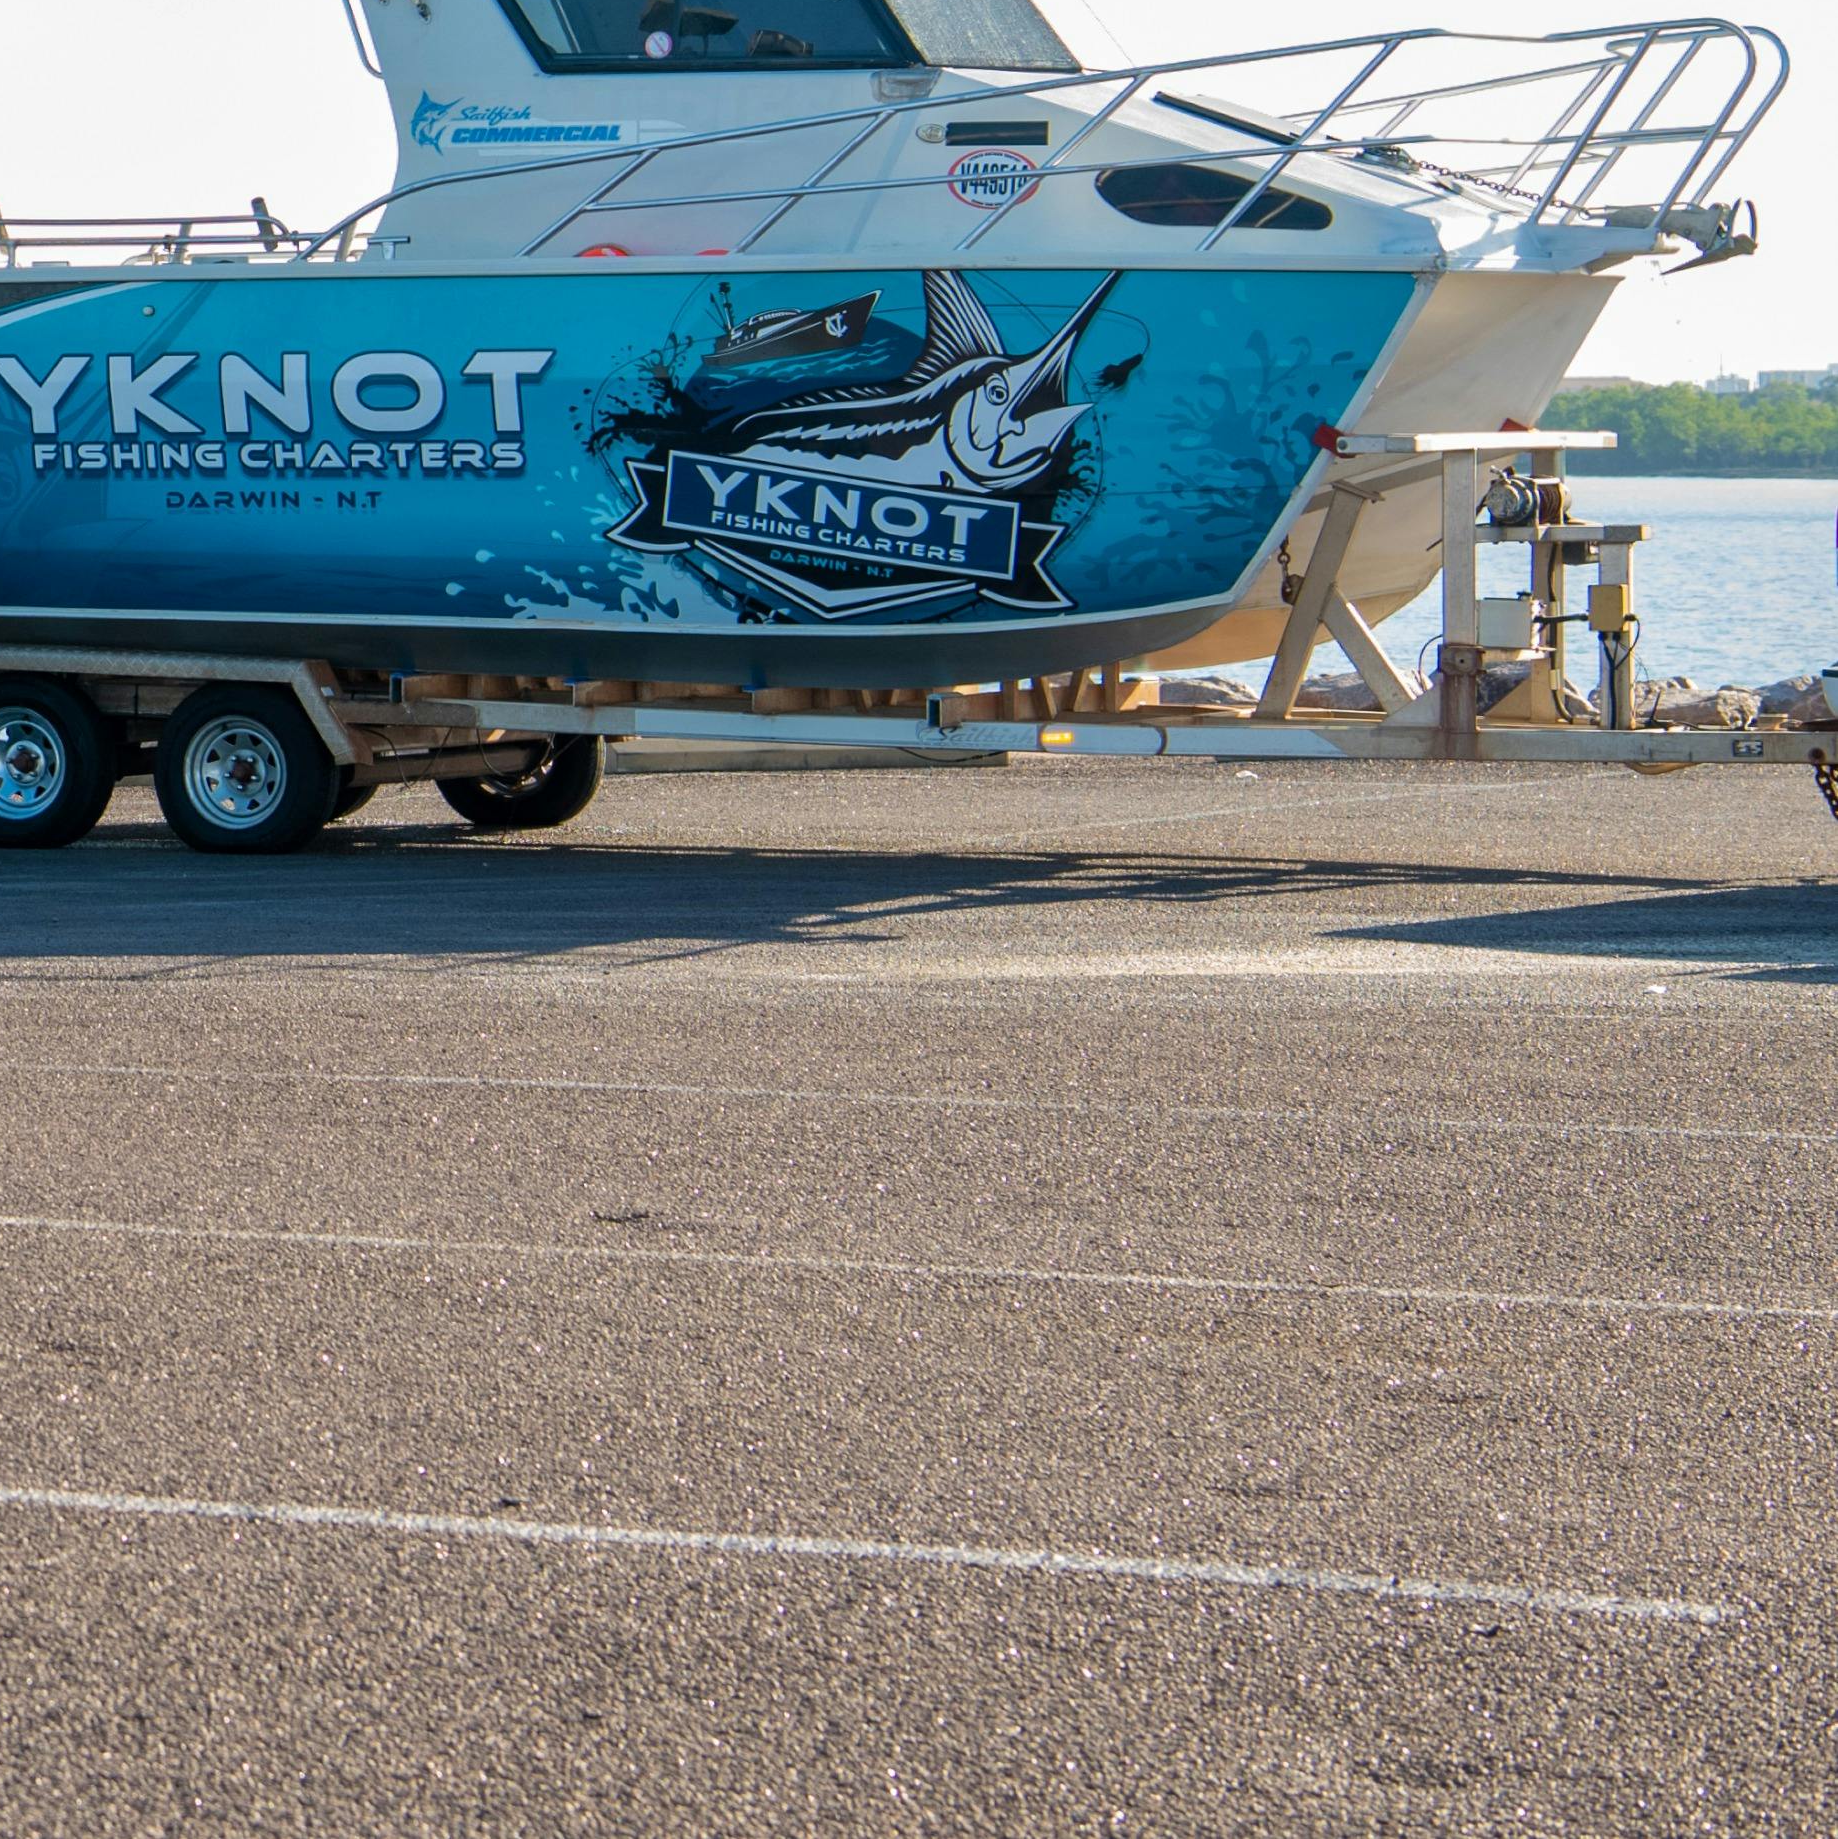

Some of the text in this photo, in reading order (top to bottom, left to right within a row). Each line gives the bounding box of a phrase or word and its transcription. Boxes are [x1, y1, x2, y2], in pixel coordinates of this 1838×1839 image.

[451, 105, 531, 126] Sailfish
[451, 125, 621, 143] COMMERCIAL
[33, 441, 525, 470] FISHING CHARTERS
[165, 491, 300, 509] DARWIN
[696, 465, 988, 546] YKNOT
[711, 511, 966, 562] FISHING CHARTERS
[769, 549, 847, 572] DARWIN
